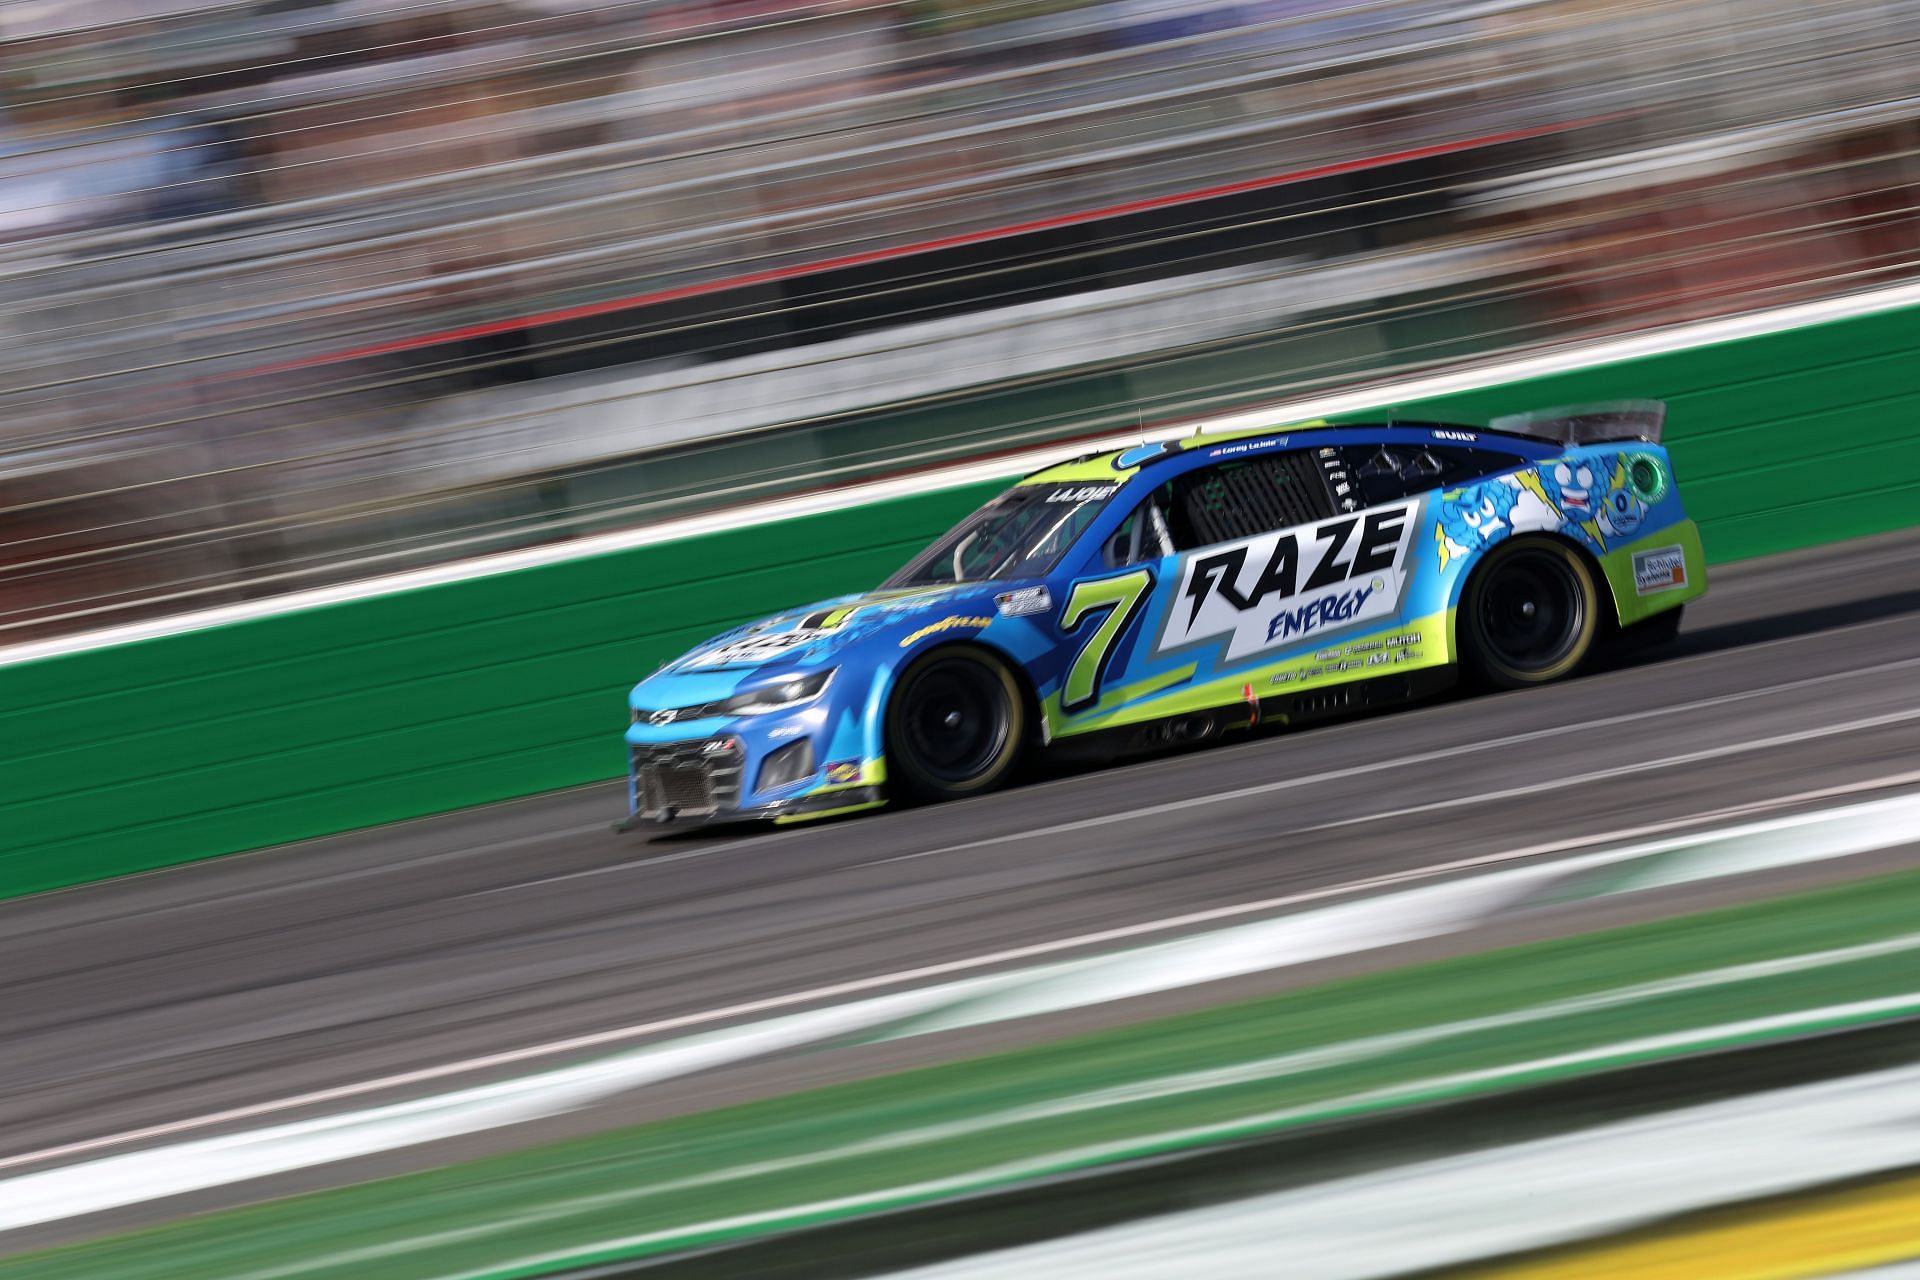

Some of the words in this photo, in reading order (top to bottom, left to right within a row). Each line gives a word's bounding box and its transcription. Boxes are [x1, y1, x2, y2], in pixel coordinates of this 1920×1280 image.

[1434, 429, 1478, 442] BUILT
[1185, 506, 1409, 637] RAZE
[1265, 587, 1374, 644] ENERGY
[1060, 568, 1157, 716] 7
